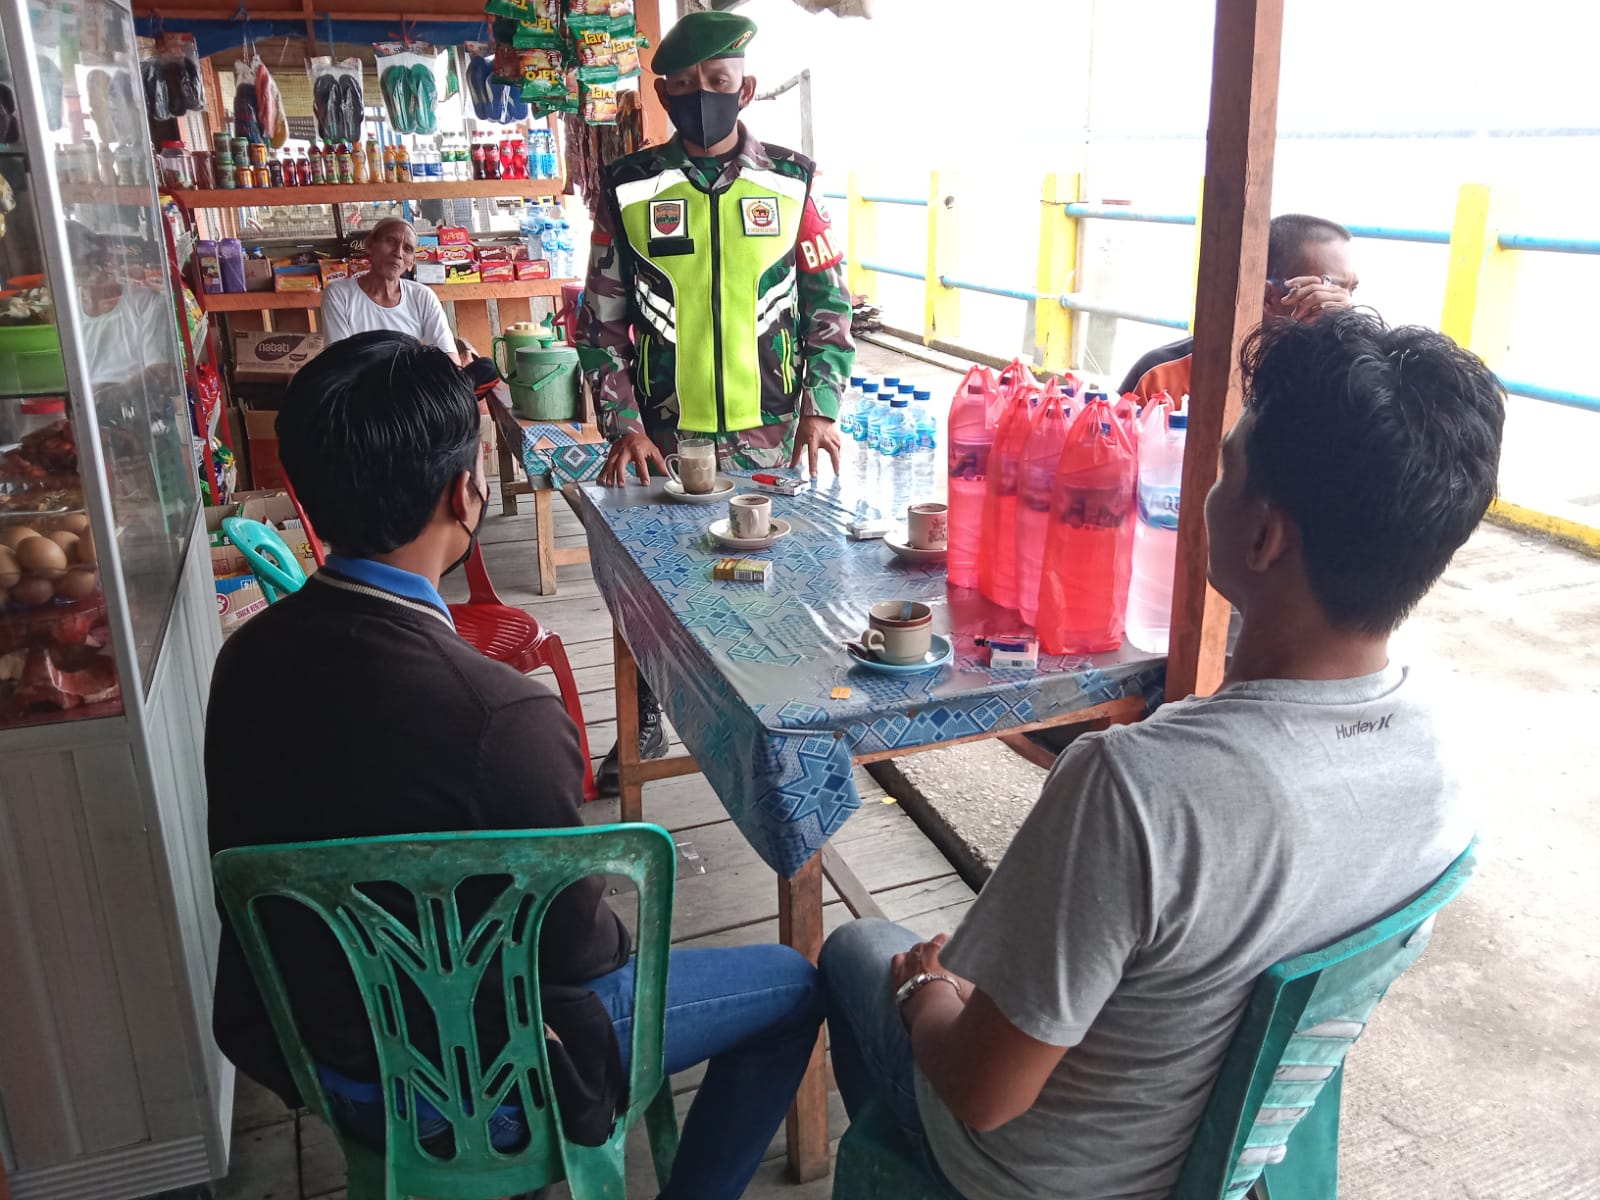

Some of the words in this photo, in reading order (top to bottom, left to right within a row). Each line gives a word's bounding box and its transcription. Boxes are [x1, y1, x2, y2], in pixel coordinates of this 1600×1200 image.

[580, 29, 611, 46] Taro
[525, 68, 560, 85] Taro
[590, 84, 616, 99] Taro
[258, 342, 290, 353] nabati
[1335, 719, 1378, 740] Hurley
